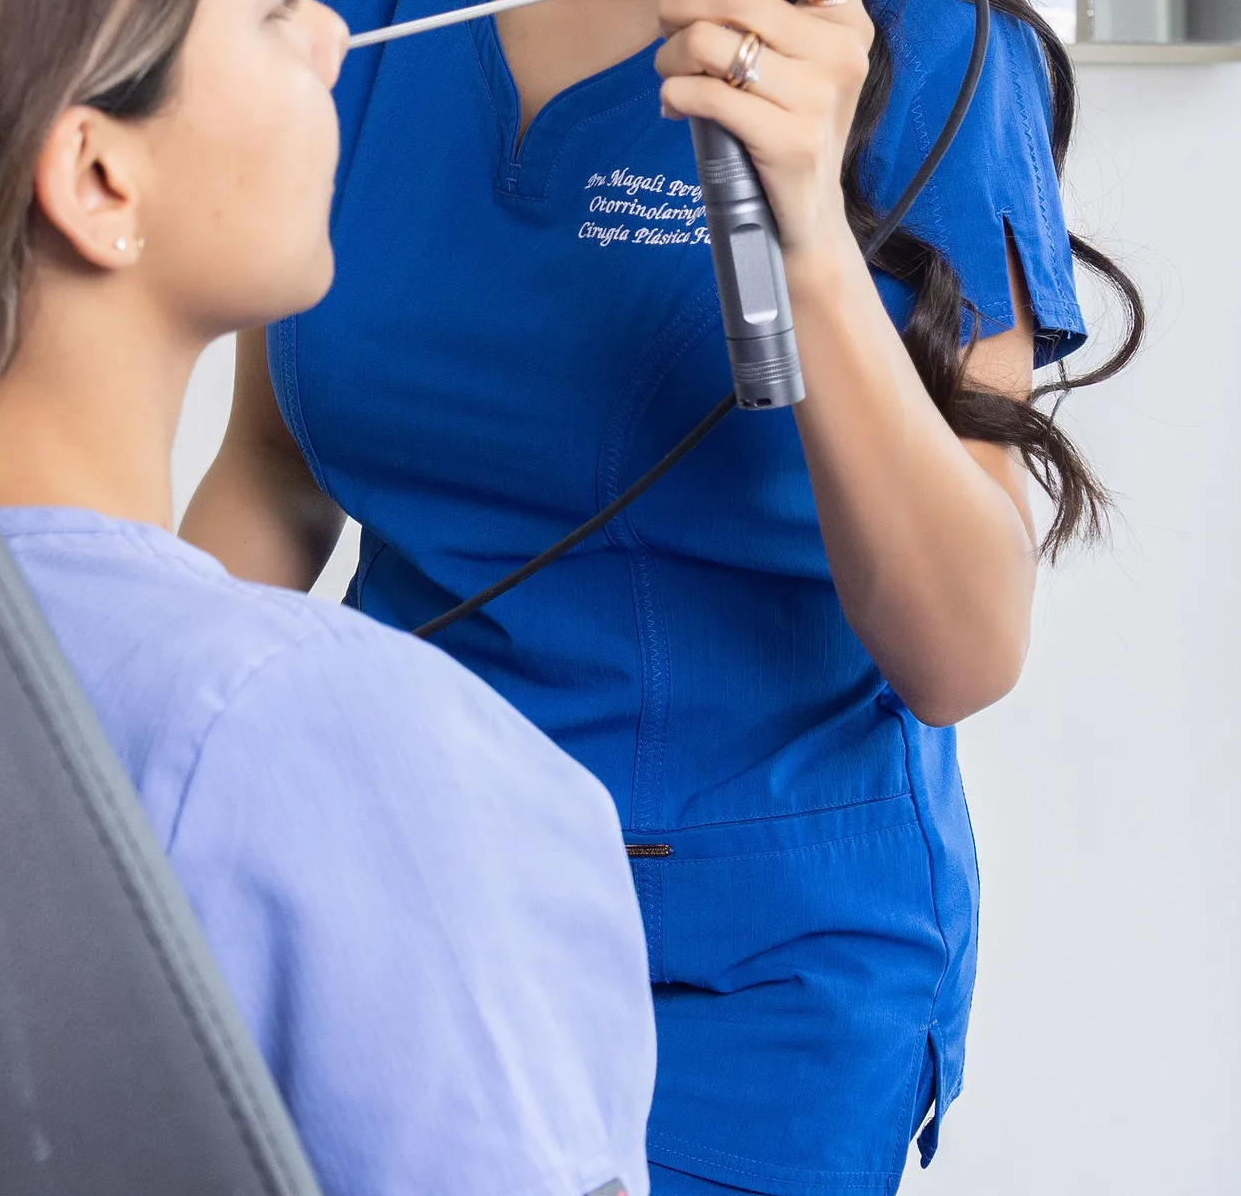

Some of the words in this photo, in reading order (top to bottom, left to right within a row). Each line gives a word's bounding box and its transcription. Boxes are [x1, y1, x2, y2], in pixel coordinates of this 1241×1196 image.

[606, 167, 666, 196] Magali
[578, 220, 631, 248] Cirugía
[631, 226, 692, 246] Plástica
